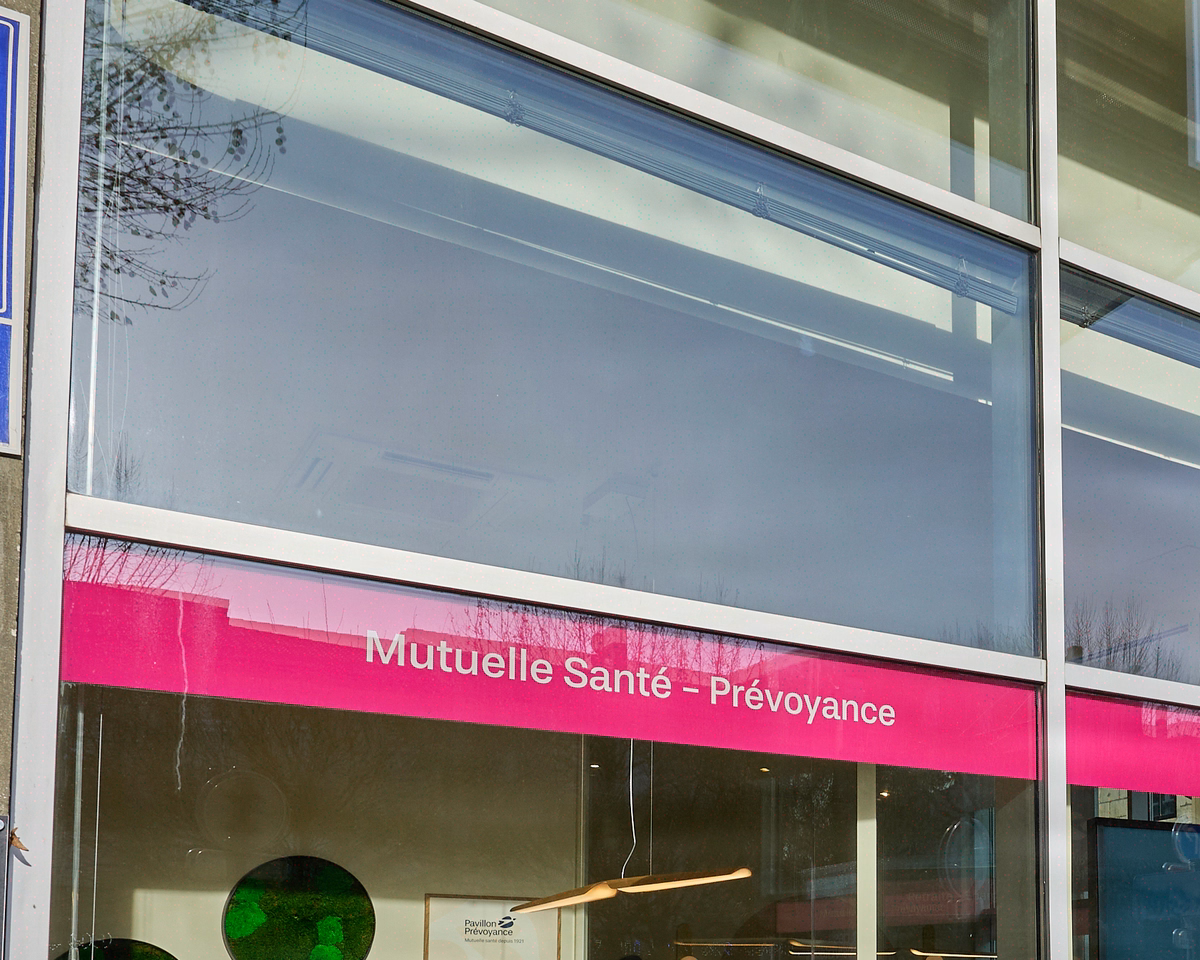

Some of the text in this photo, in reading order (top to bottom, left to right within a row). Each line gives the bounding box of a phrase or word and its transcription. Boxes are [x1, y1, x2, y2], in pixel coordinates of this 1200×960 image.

[365, 629, 554, 686] Mutuelle
[563, 654, 673, 700] Santé
[709, 676, 897, 728] Prévoyance
[464, 919, 497, 928] Pavillon
[464, 927, 514, 938] Prévoyance
